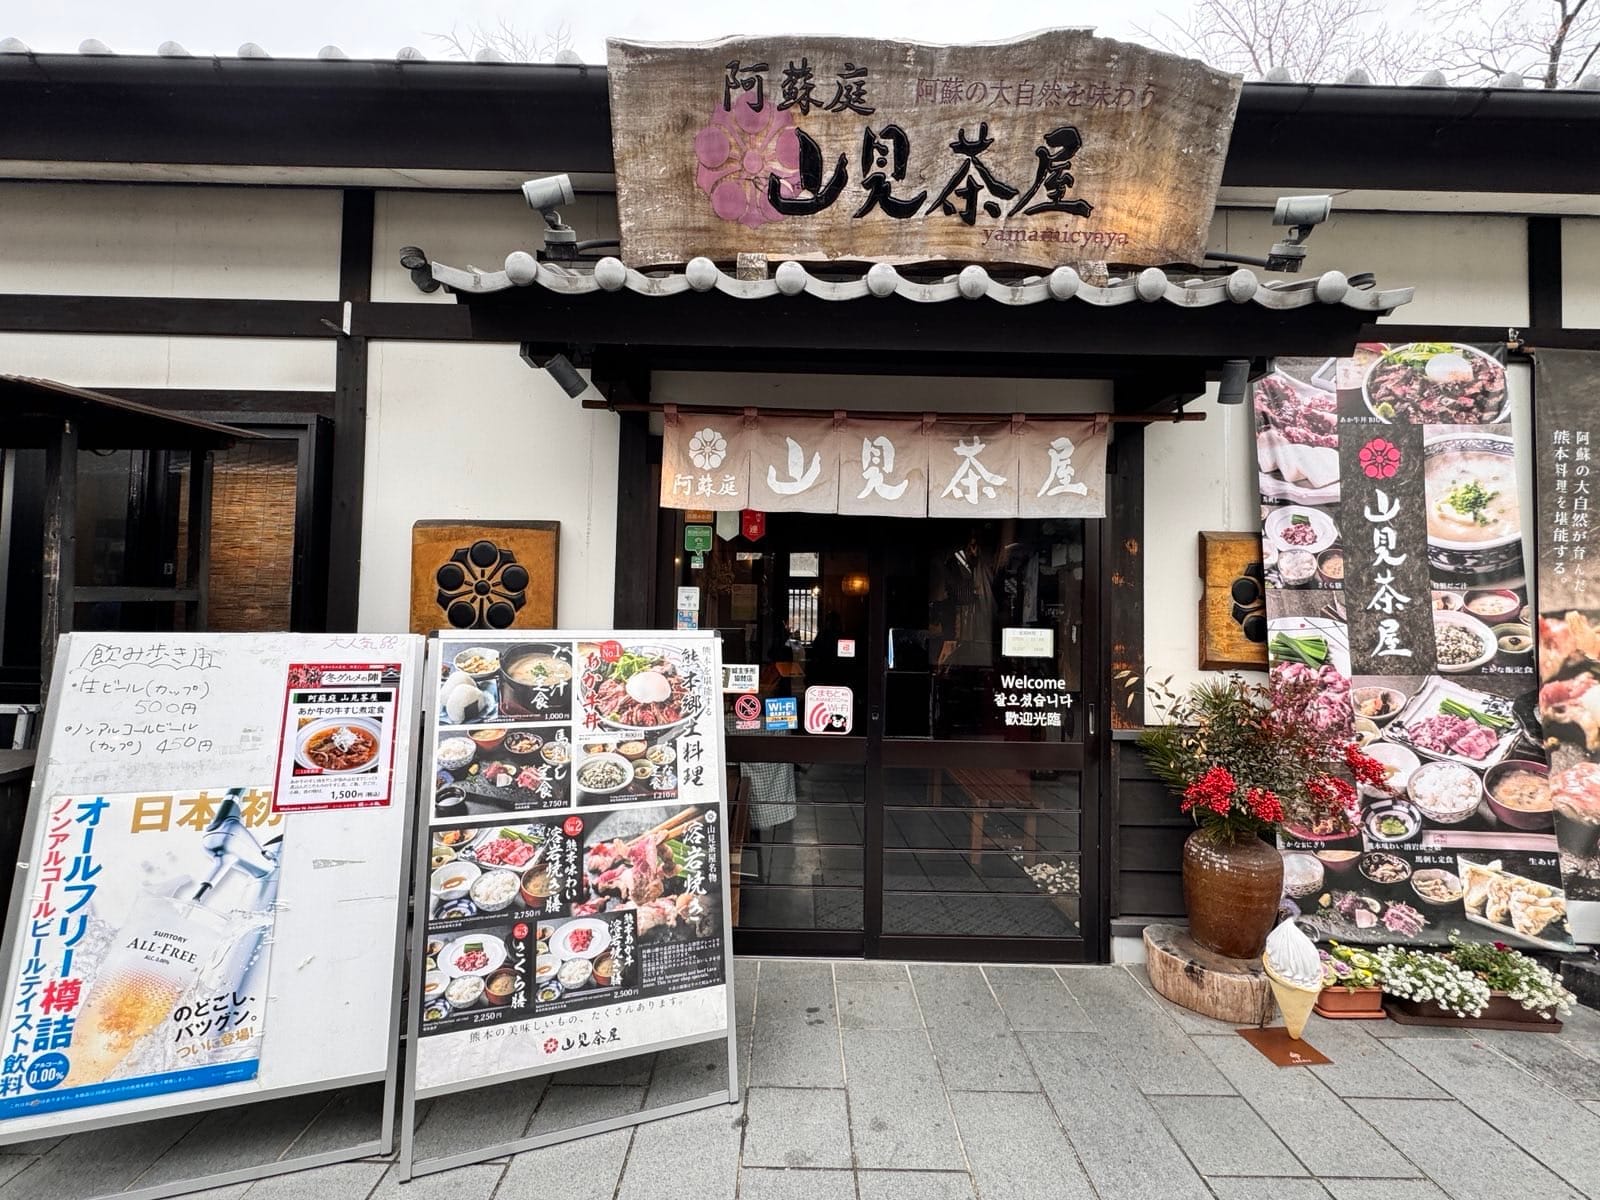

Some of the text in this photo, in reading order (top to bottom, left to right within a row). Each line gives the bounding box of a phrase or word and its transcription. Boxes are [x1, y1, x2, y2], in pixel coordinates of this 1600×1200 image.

[724, 60, 876, 117] 阿蘇庭
[915, 77, 1158, 112] 阿蘇の大自然を味わう
[768, 121, 1094, 226] 山見茶屋
[767, 435, 1089, 505] 山見茶屋
[672, 473, 740, 498] 阿蘇庭
[1553, 429, 1572, 584] 熊本料理を堪能する。
[1572, 430, 1591, 592] 阿蘇の大自然が育んだ
[1363, 487, 1412, 658] 山見茶屋
[80, 643, 214, 667] 飲み歩き用
[582, 651, 603, 732] あか牛丼
[1001, 674, 1066, 689] Welcome
[135, 700, 198, 715] 500円
[298, 705, 386, 716] あか牛の牛すじ煮定食
[681, 647, 706, 788] 熊本郷土料理
[768, 702, 794, 712] Wi-Fi
[1005, 711, 1062, 727] 歡迎光臨
[156, 736, 214, 755] 450円
[564, 839, 578, 900] 熊本味わい
[33, 797, 110, 1052] オールフリー樽詰
[153, 929, 188, 944] SUNTORY
[0, 798, 72, 1097] ノンアルコールビールテイスト飲料
[126, 937, 198, 965] ALL-FREE
[510, 941, 527, 1009] さくら膳
[174, 992, 255, 1022] のどごし、
[174, 1011, 257, 1042] バツグン。
[561, 1027, 621, 1052] 山見茶屋
[29, 1068, 64, 1084] 0.00%
[34, 1059, 64, 1069] アルコール
